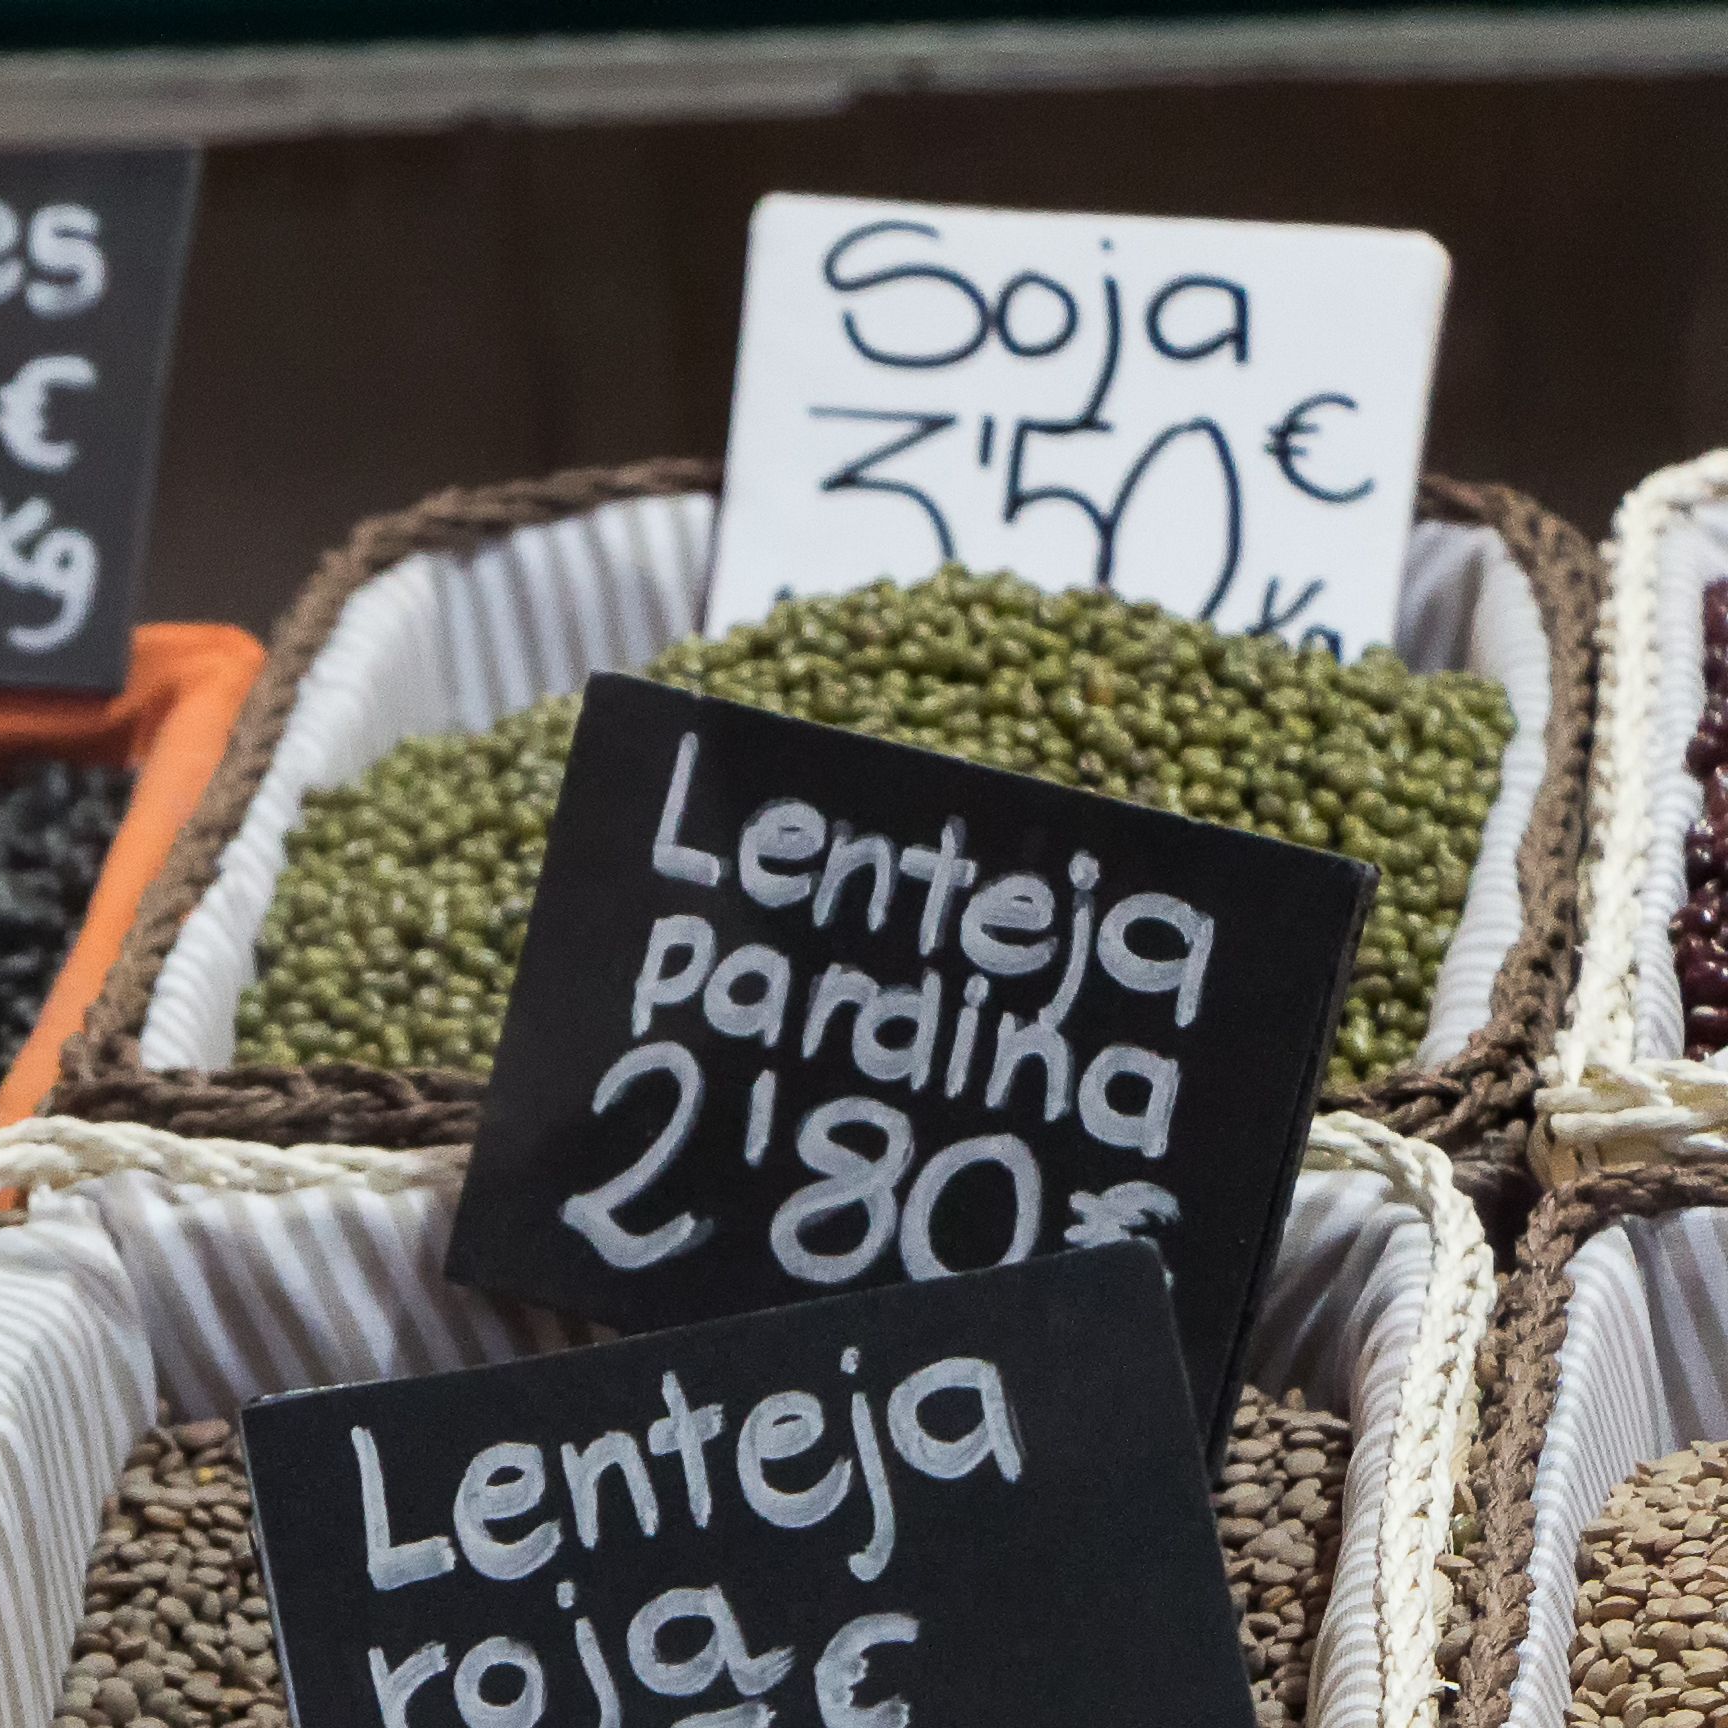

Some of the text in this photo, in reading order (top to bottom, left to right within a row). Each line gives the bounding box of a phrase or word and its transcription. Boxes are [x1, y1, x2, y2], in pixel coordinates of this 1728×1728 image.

[823, 219, 1250, 426] Soja
[1266, 391, 1375, 504] €
[650, 730, 1215, 1030] Lenteja
[559, 1040, 1044, 1284] 2'80
[350, 1346, 1024, 1592] Lenteja
